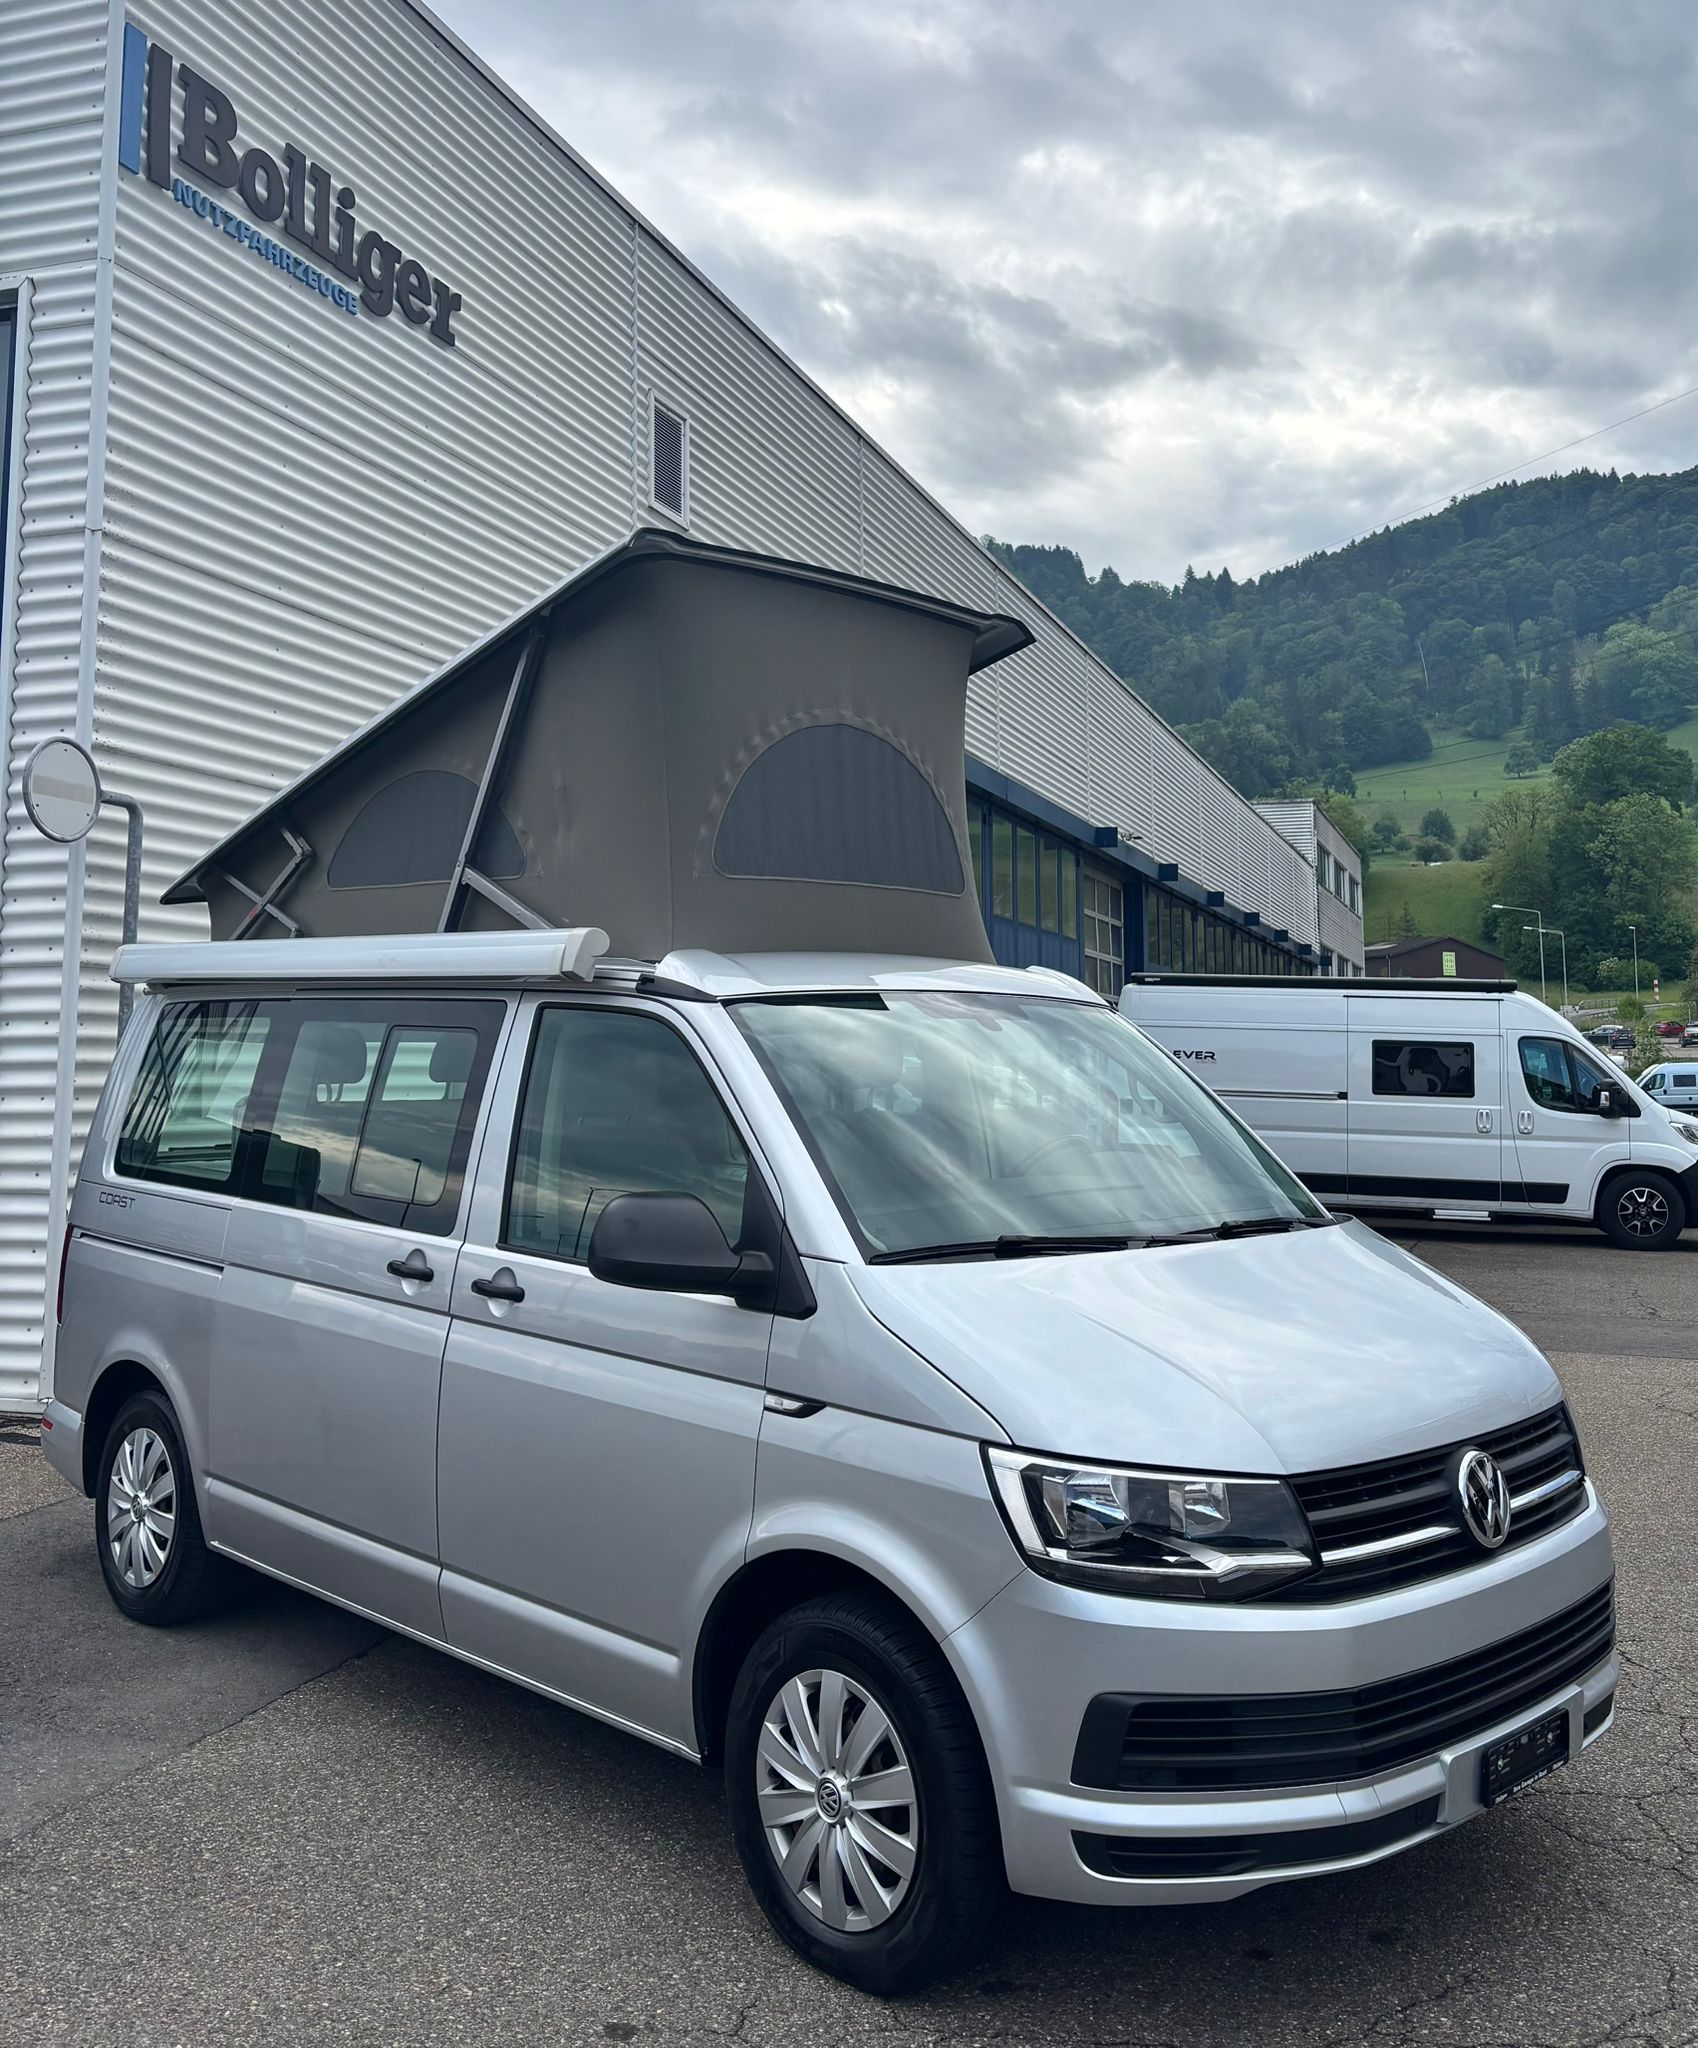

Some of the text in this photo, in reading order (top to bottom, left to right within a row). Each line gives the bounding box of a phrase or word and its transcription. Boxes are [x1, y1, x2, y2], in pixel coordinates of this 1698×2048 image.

[173, 178, 358, 316] NUTZFAHRZEUGE
[178, 63, 462, 346] Bolliger
[99, 1191, 136, 1210] COAST
